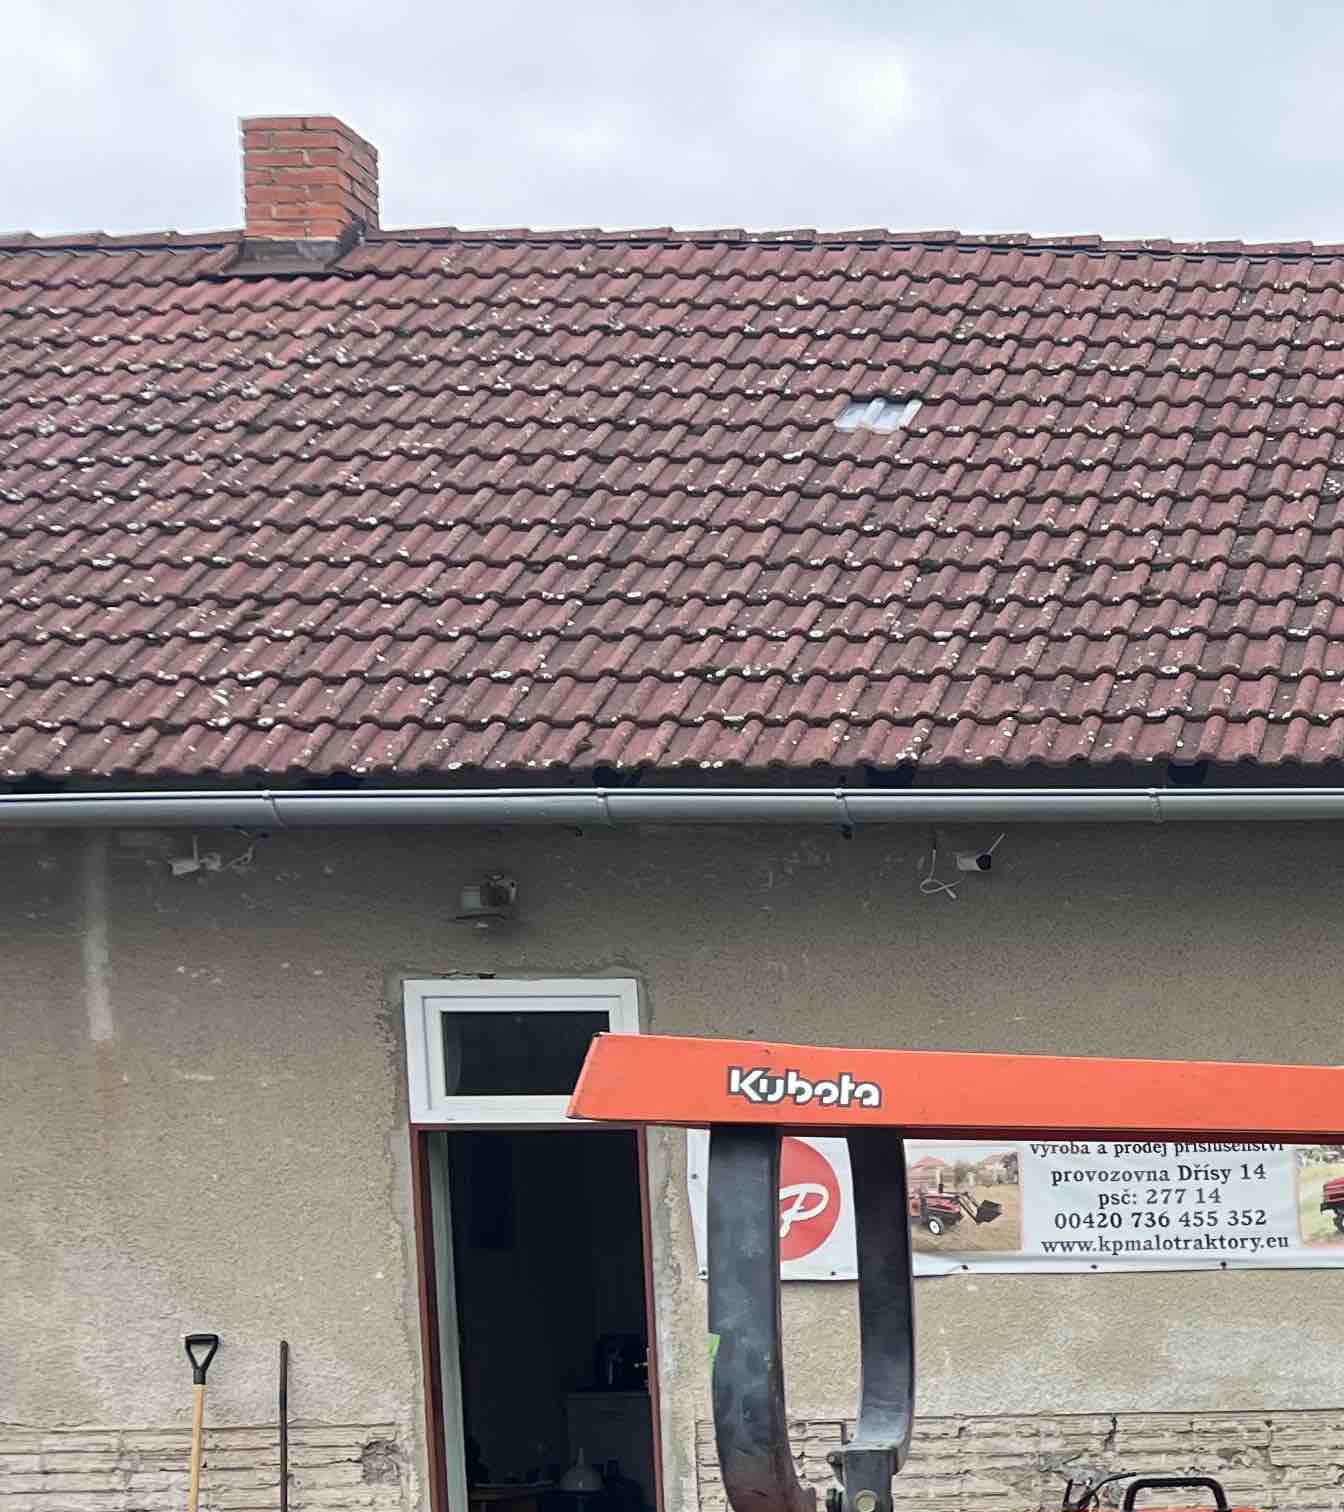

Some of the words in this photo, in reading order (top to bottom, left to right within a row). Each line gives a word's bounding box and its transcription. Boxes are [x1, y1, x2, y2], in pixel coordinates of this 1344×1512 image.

[728, 1066, 881, 1108] Kubota
[1097, 1143, 1108, 1154] a
[1051, 1169, 1170, 1186] provozovna
[1178, 1164, 1232, 1184] Dřísy
[1240, 1164, 1267, 1180] 14
[1099, 1189, 1137, 1209] psč:
[1146, 1189, 1186, 1204] 277
[1195, 1188, 1222, 1204] 14
[1054, 1213, 1123, 1229] 00420
[1131, 1212, 1170, 1228] 736
[1179, 1211, 1219, 1228] 455
[1227, 1210, 1268, 1226] 352
[1041, 1233, 1289, 1255] www.kpmalotraktory.eu
